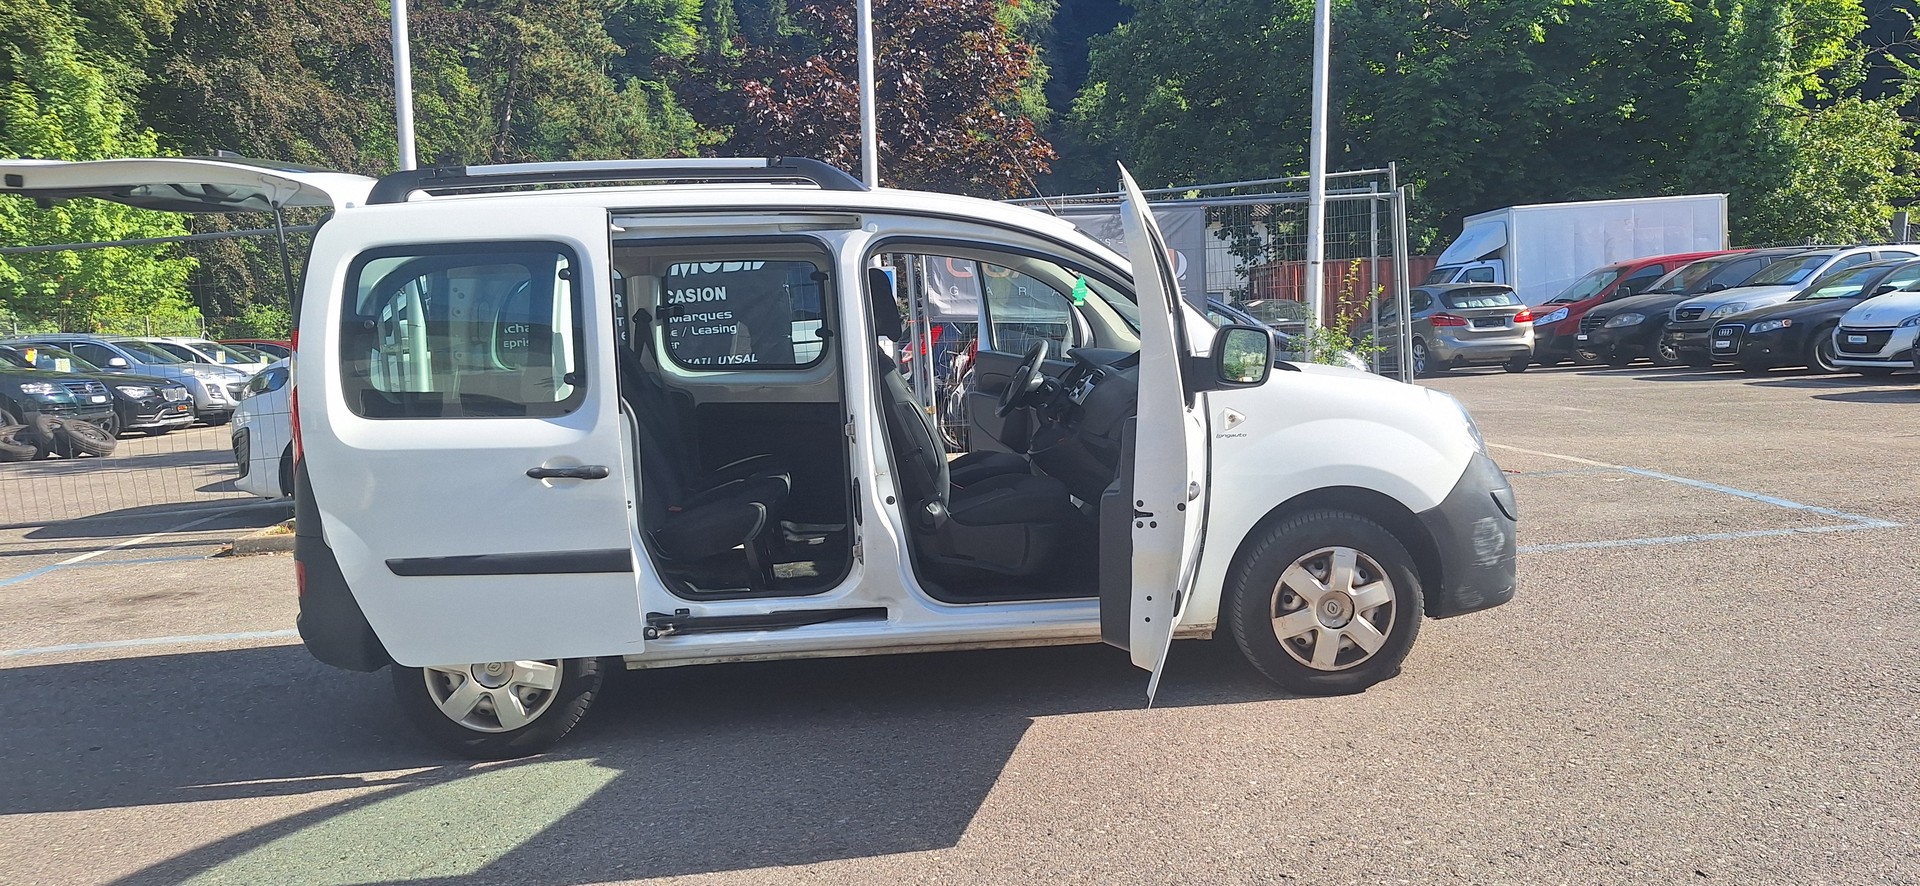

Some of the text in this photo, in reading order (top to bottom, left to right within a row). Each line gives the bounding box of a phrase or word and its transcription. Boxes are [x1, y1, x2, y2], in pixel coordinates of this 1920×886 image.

[669, 311, 732, 323] Marques
[691, 324, 737, 335] Leasing
[718, 353, 758, 365] UYSAL
